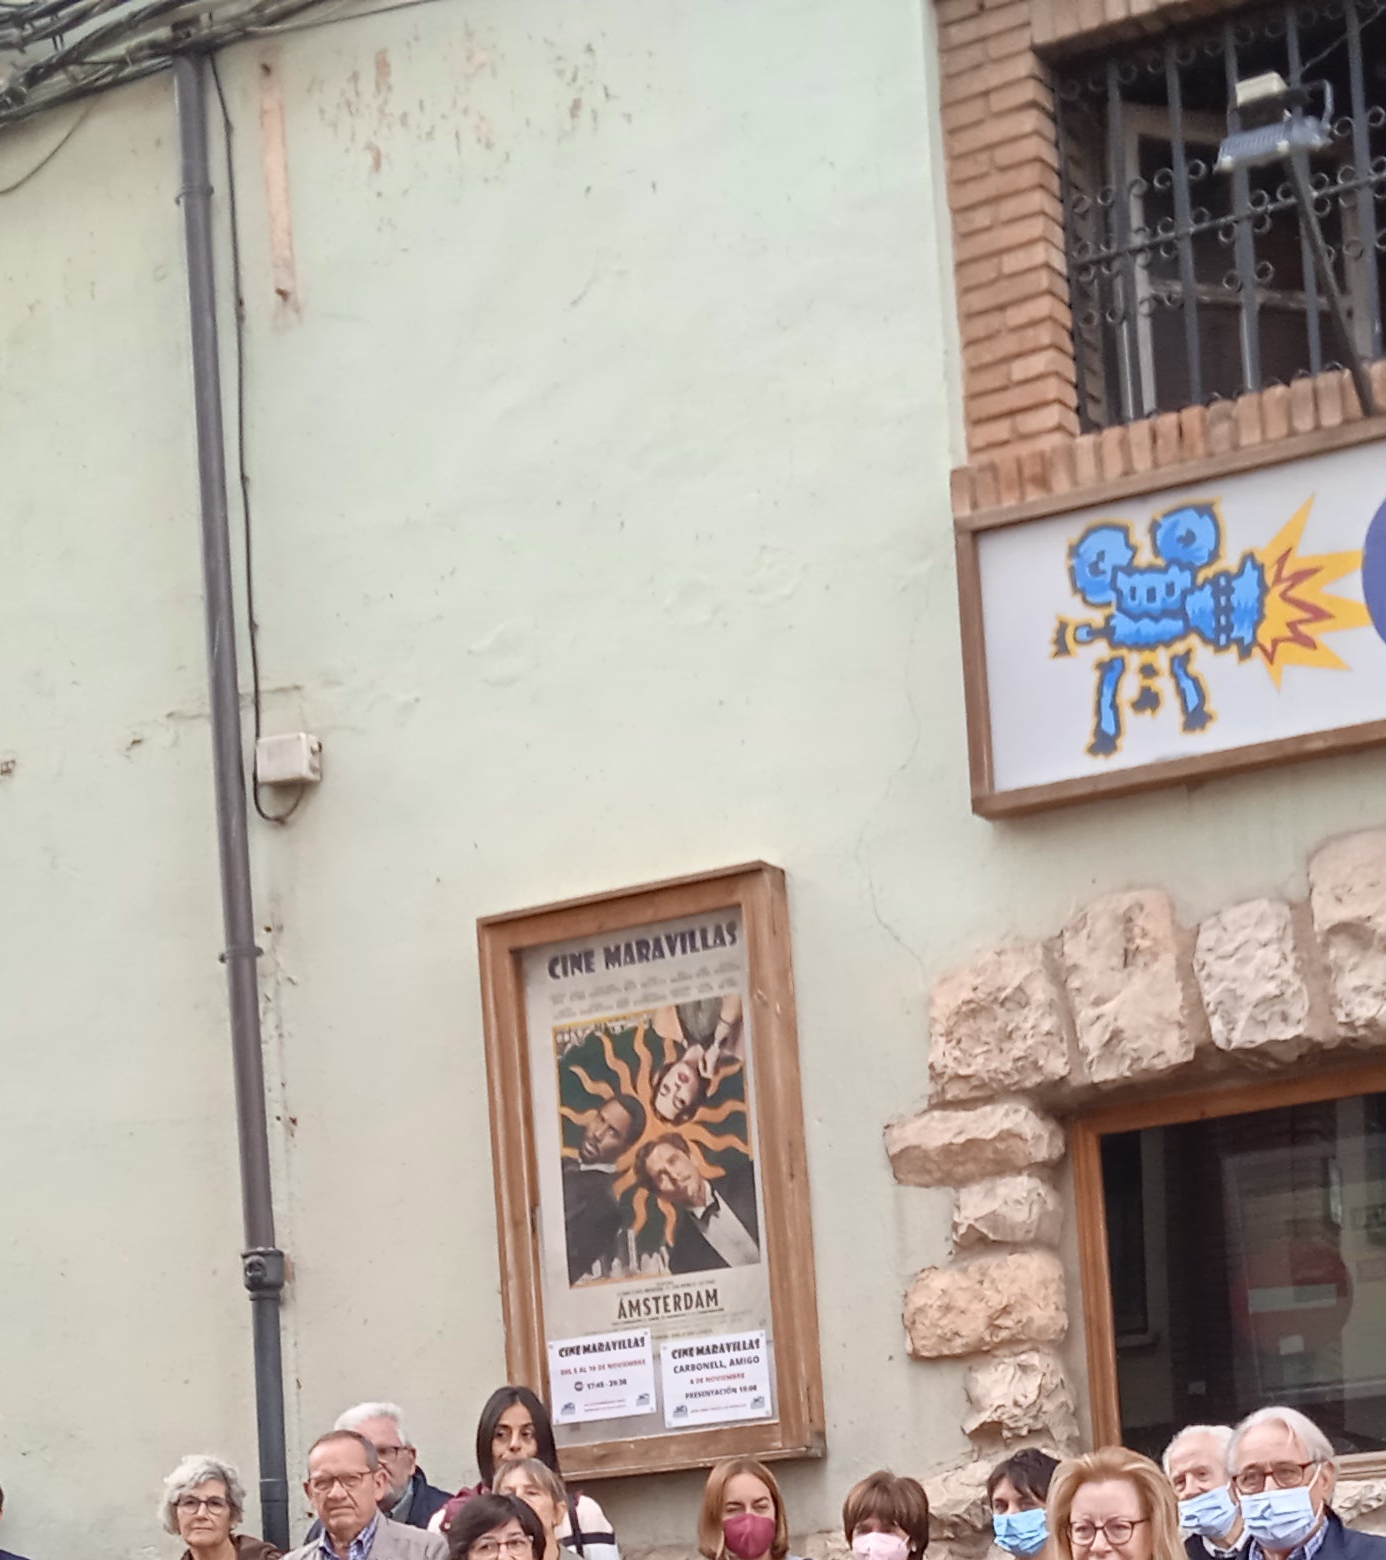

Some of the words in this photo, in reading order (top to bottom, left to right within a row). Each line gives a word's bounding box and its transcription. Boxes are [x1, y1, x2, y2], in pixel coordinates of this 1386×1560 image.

[547, 948, 596, 980] CINE
[603, 920, 738, 970] MARAVILLAS
[558, 1345, 581, 1358] CINE
[582, 1336, 645, 1354] MARAVILLAS
[671, 1348, 694, 1360] CINE
[696, 1338, 761, 1356] MARAVILLAS
[607, 1359, 646, 1370] NOVIEMBRE
[729, 1355, 760, 1367] AMIGO
[706, 1372, 745, 1383] NOVIEMBRE
[685, 1387, 738, 1399] PRESENTACIÓN
